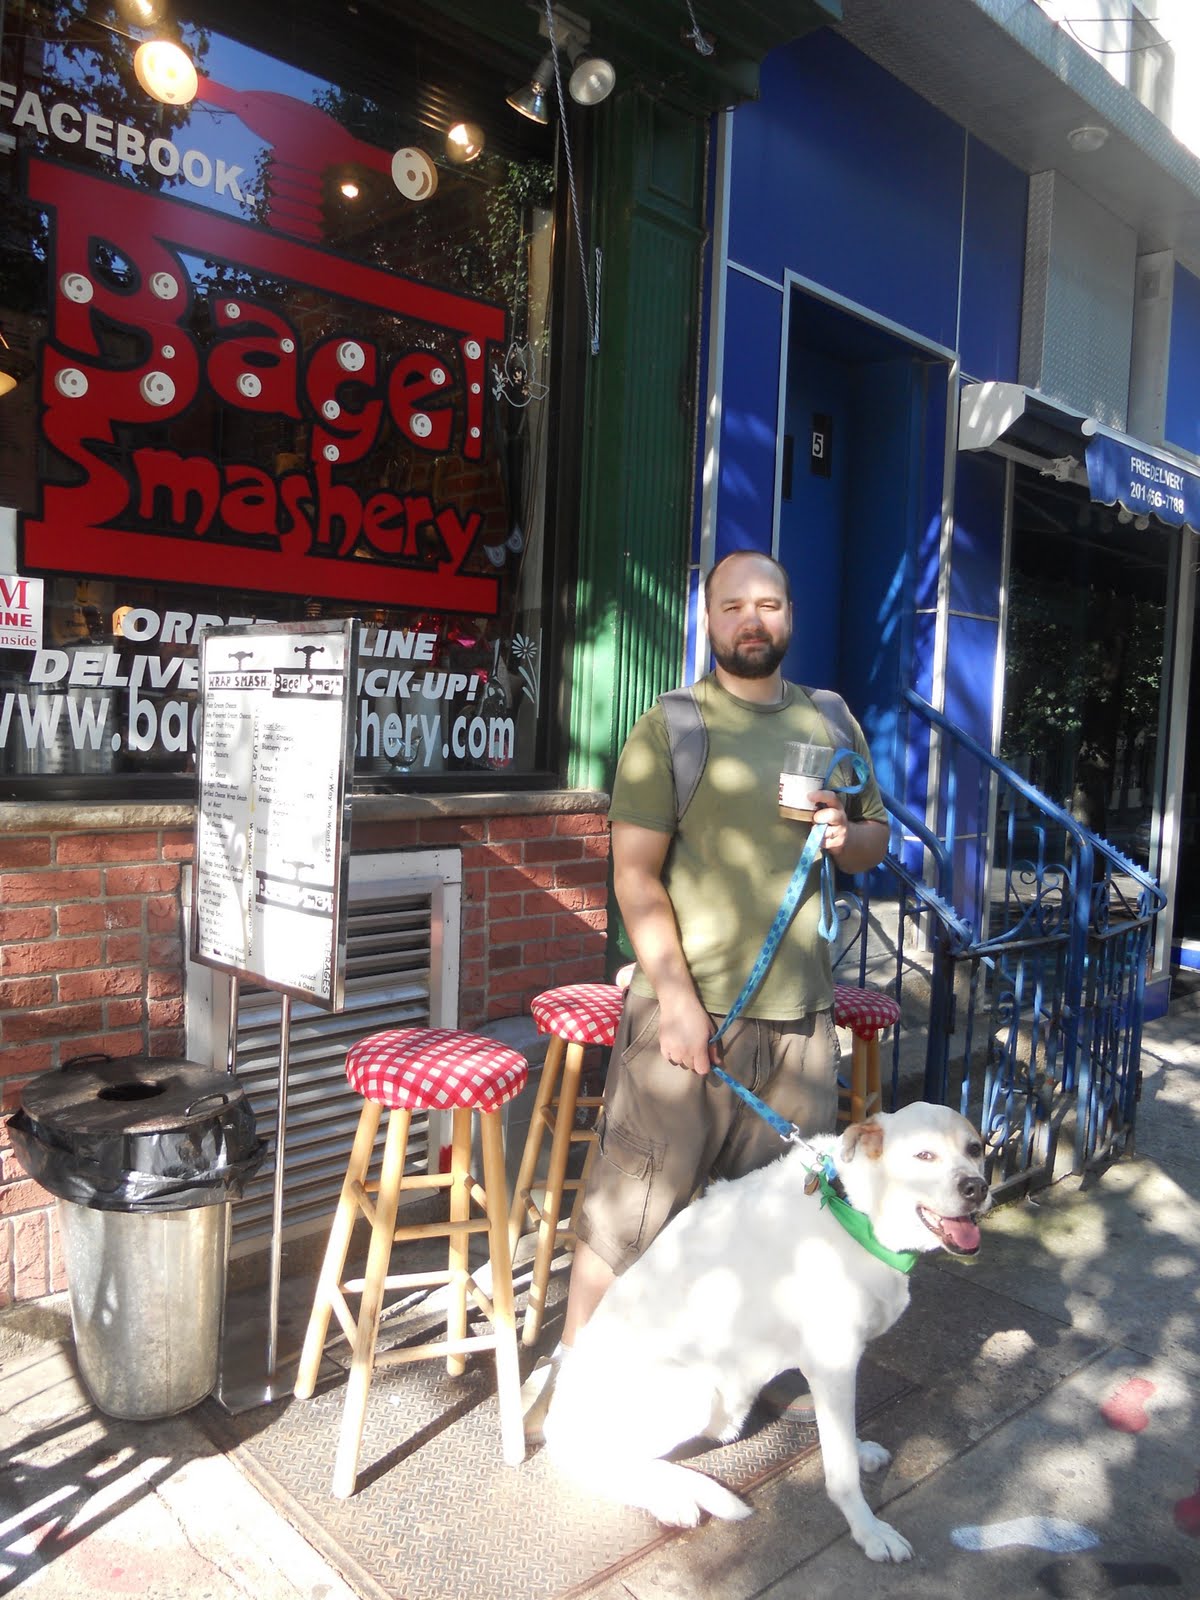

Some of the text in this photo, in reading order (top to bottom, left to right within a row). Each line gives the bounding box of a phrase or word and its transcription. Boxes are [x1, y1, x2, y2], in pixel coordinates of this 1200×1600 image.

[43, 200, 488, 465] Bagel
[813, 434, 822, 456] 5
[1131, 456, 1150, 479] FREE
[42, 408, 482, 575] Smashery
[1130, 481, 1146, 501] 201
[0, 634, 37, 647] nside
[358, 627, 438, 661] LINE
[29, 649, 479, 701] DELIVE ICK-UP!
[208, 675, 267, 688] WRAP SMASH
[354, 699, 515, 767] hery.com
